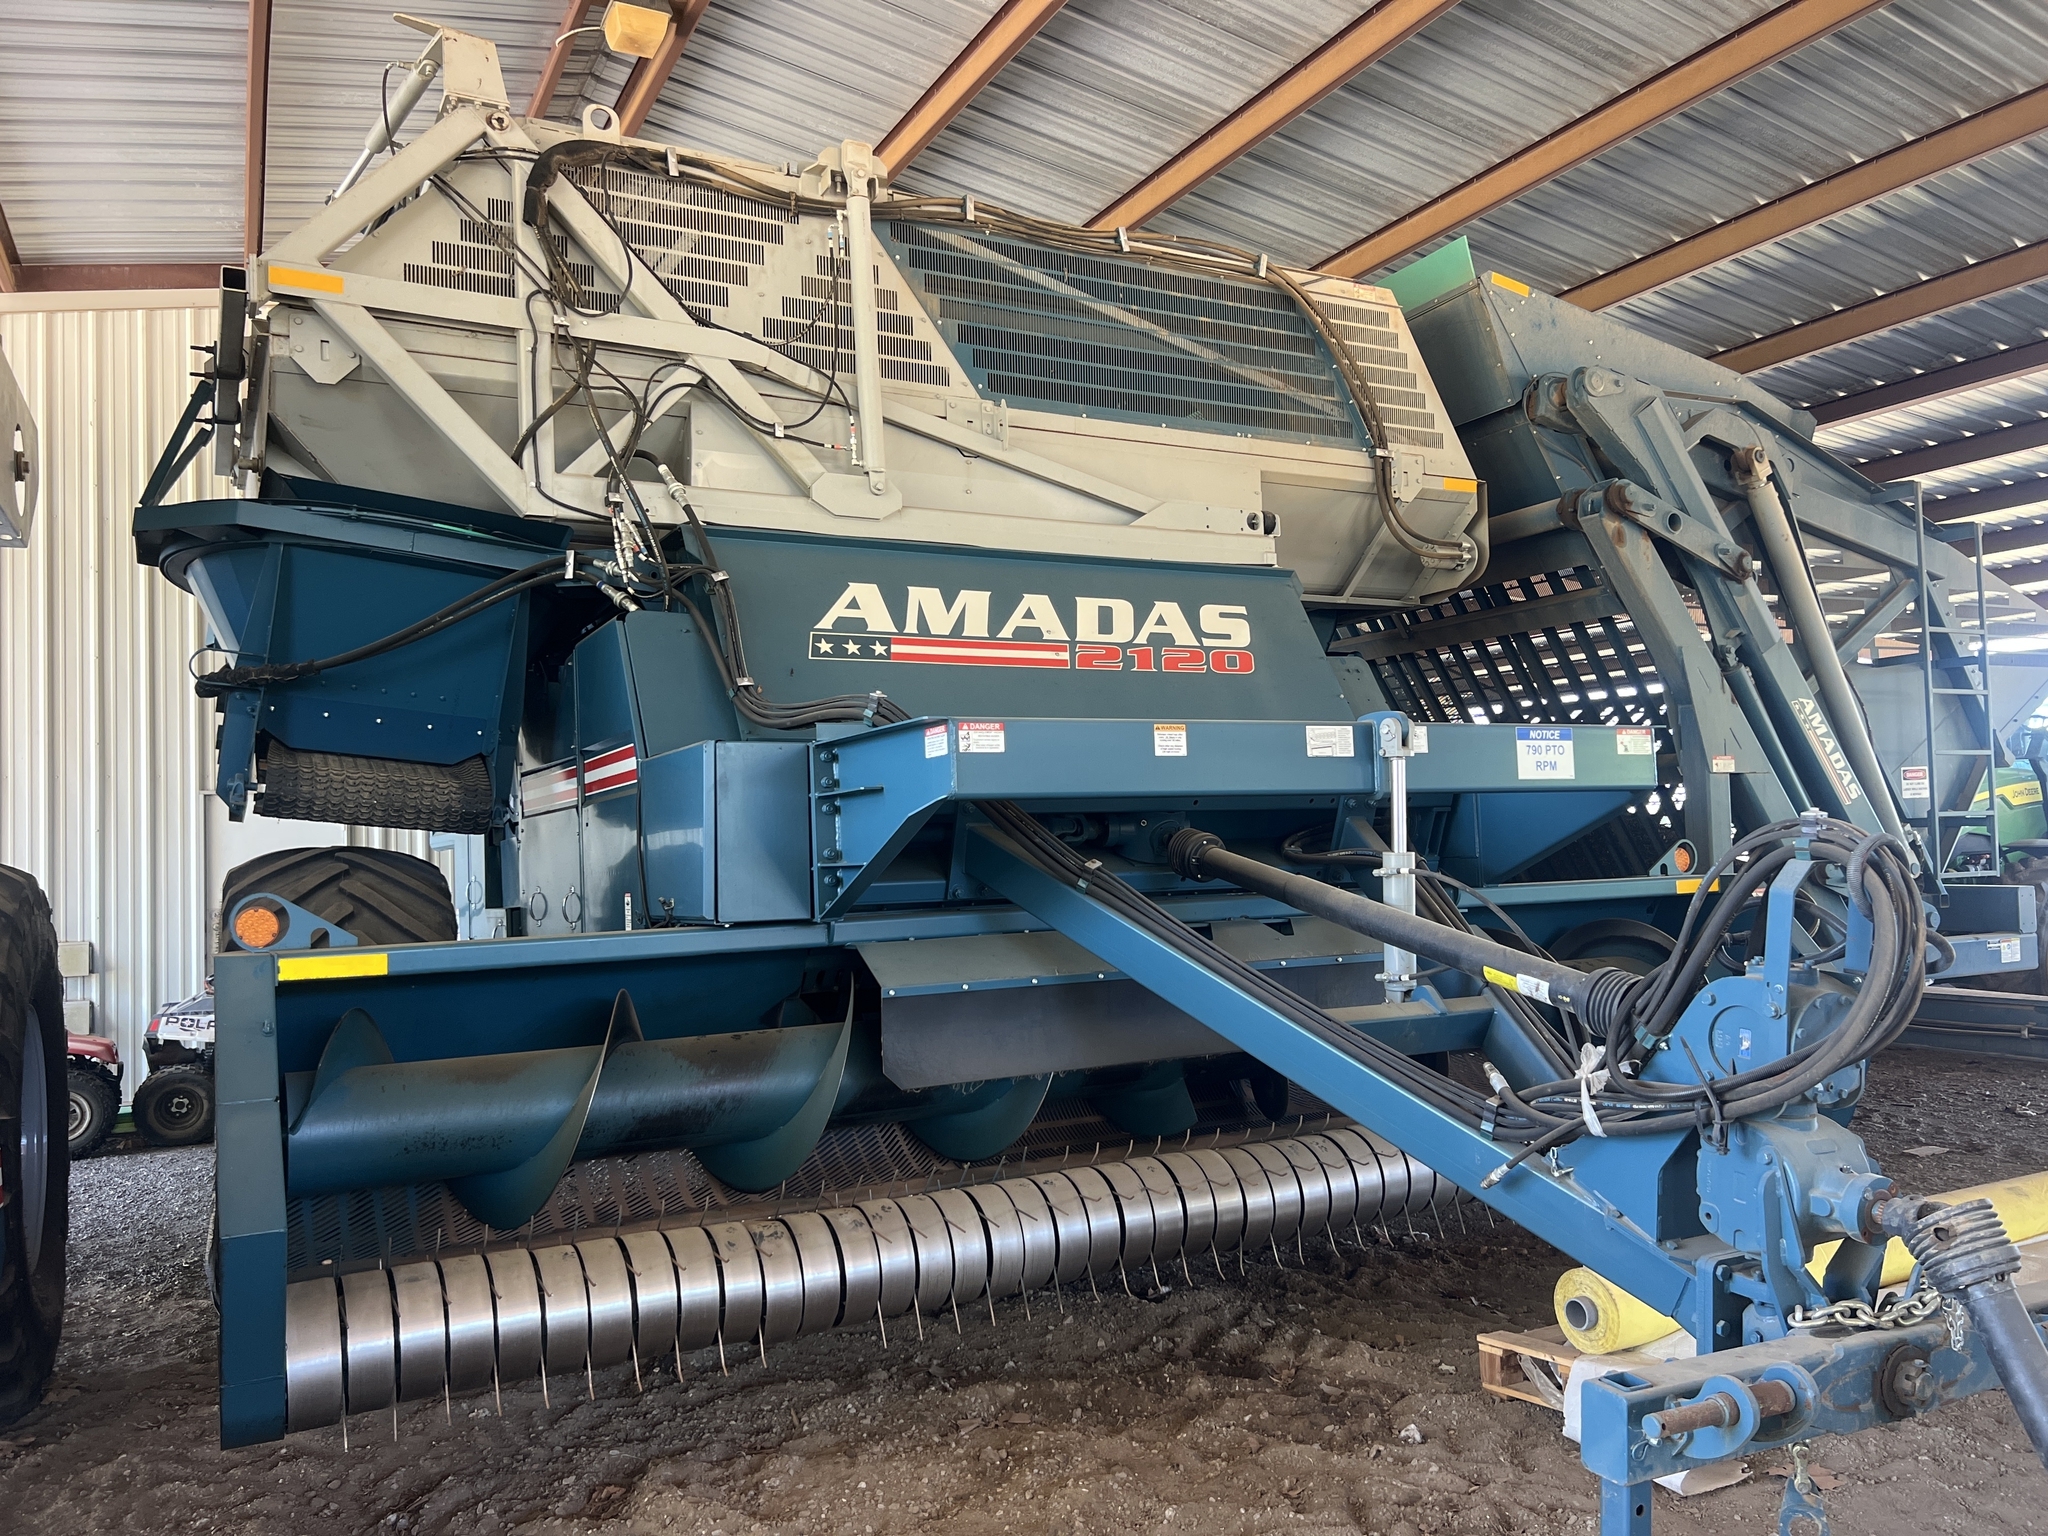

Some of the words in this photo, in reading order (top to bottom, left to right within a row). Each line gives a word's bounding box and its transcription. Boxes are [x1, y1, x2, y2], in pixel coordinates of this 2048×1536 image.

[813, 582, 1251, 648] AMADAS
[1075, 643, 1255, 675] 2120
[969, 722, 1001, 730] DANGER
[1529, 730, 1561, 740] NOTICE
[1526, 744, 1543, 756] 790
[1545, 744, 1565, 756] PTO
[1797, 697, 1862, 800] AMADAS
[1535, 760, 1558, 771] RPM
[2012, 789, 2025, 799] JOHN
[2024, 787, 2040, 797] DEERE
